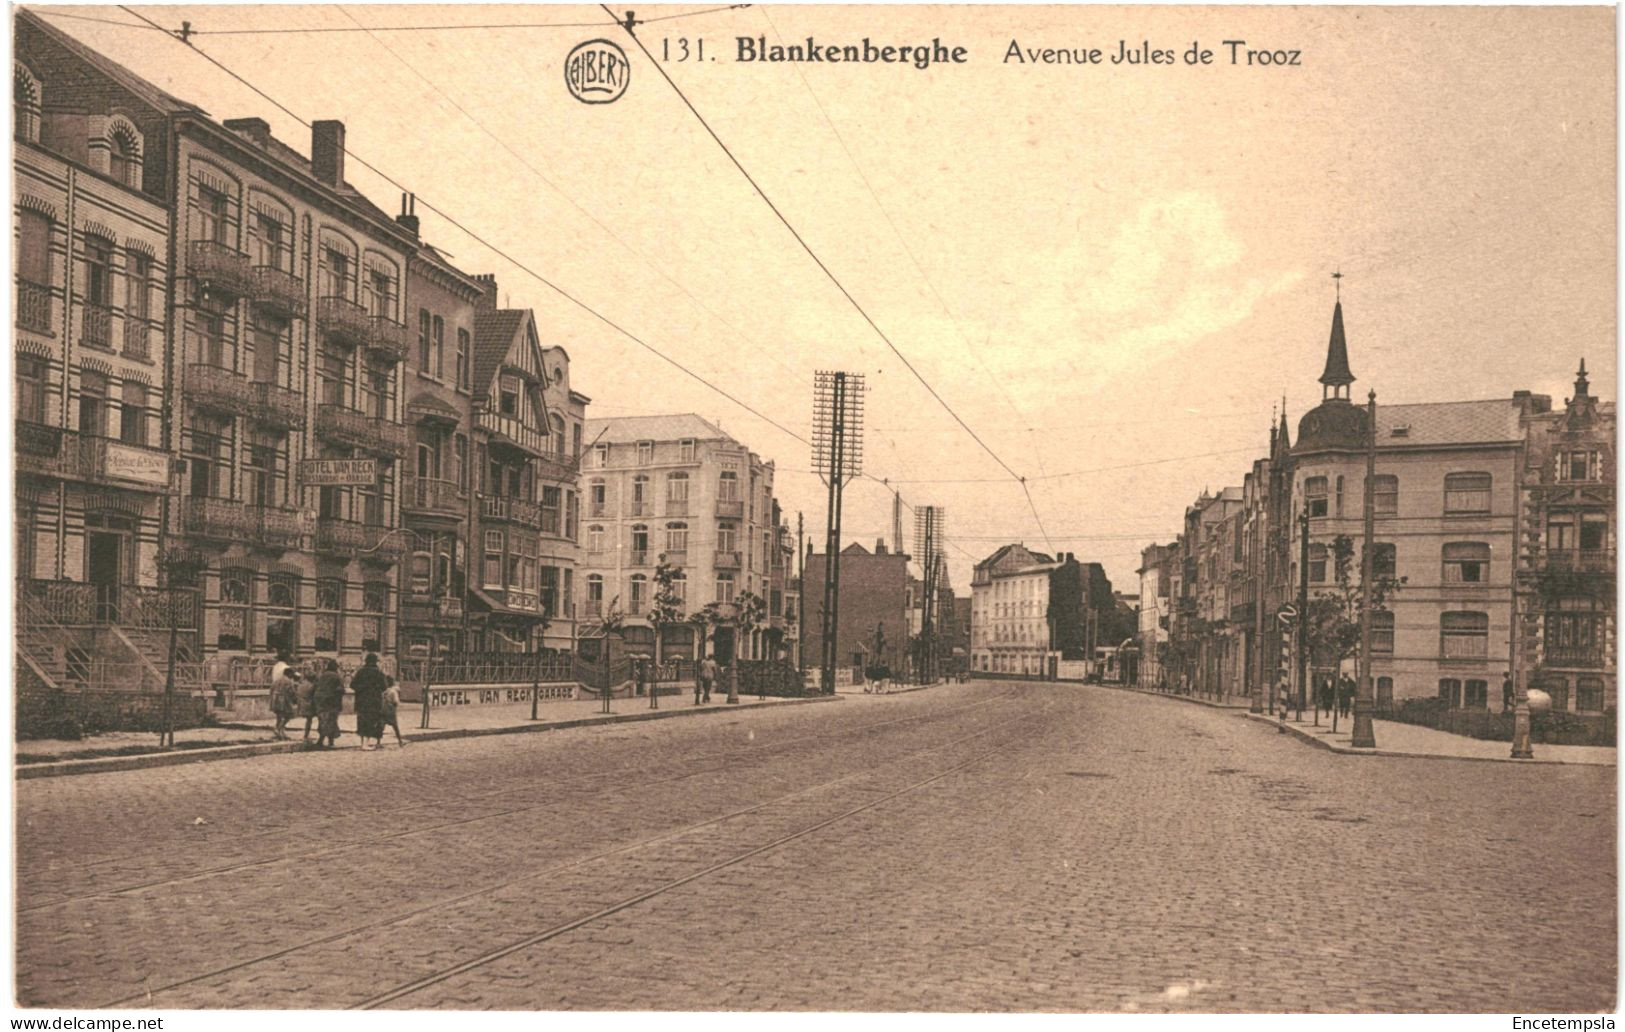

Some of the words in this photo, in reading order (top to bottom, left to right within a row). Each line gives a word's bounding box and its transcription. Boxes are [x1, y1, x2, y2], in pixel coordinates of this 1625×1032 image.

[431, 691, 470, 706] HOTEL
[479, 690, 499, 704] VAN
[539, 687, 573, 700] GARAGE
